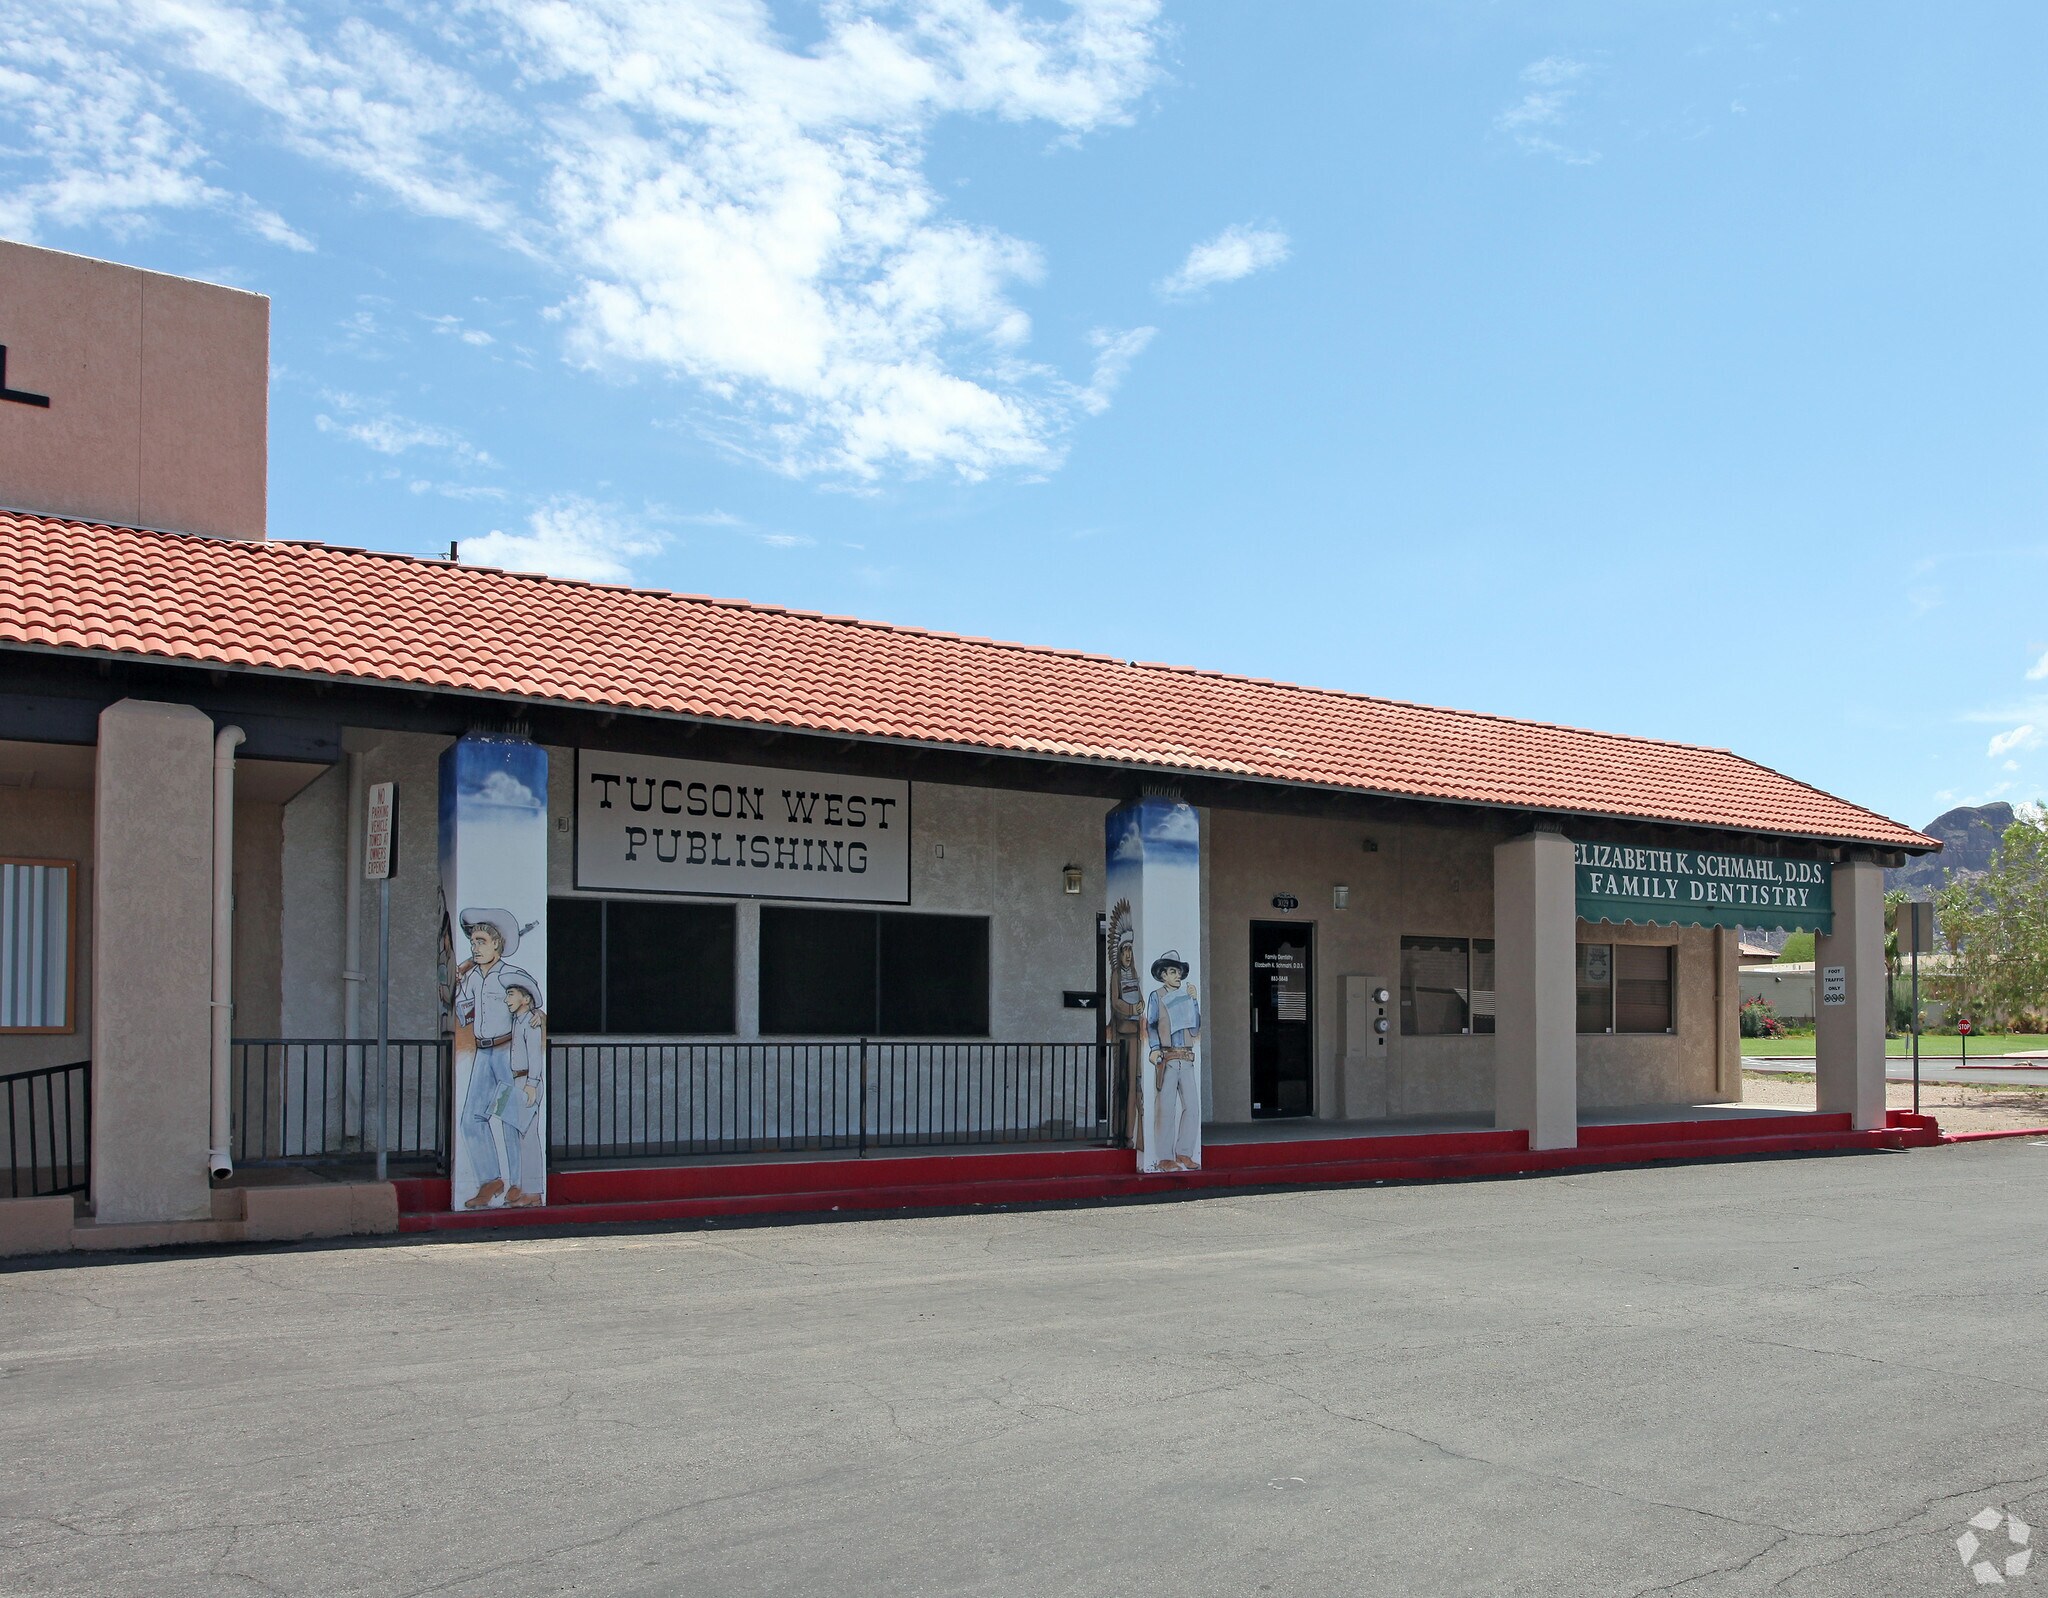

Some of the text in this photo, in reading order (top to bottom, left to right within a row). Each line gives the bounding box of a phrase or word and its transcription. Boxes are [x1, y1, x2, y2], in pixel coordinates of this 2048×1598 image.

[377, 787, 385, 805] NO
[591, 773, 896, 829] TUCSON WEST
[371, 805, 389, 819] PARKING
[371, 818, 388, 833] VEHICLE
[369, 833, 382, 847] TOWED
[625, 826, 868, 873] PUBLISHING
[368, 860, 387, 875] EXPENSE
[1574, 843, 1825, 885] ELIZABETH K. SCHMAHL, D.D.S.
[1590, 872, 1810, 907] FAMILY DENTISTRY
[1264, 953, 1293, 961] Family Dentistry
